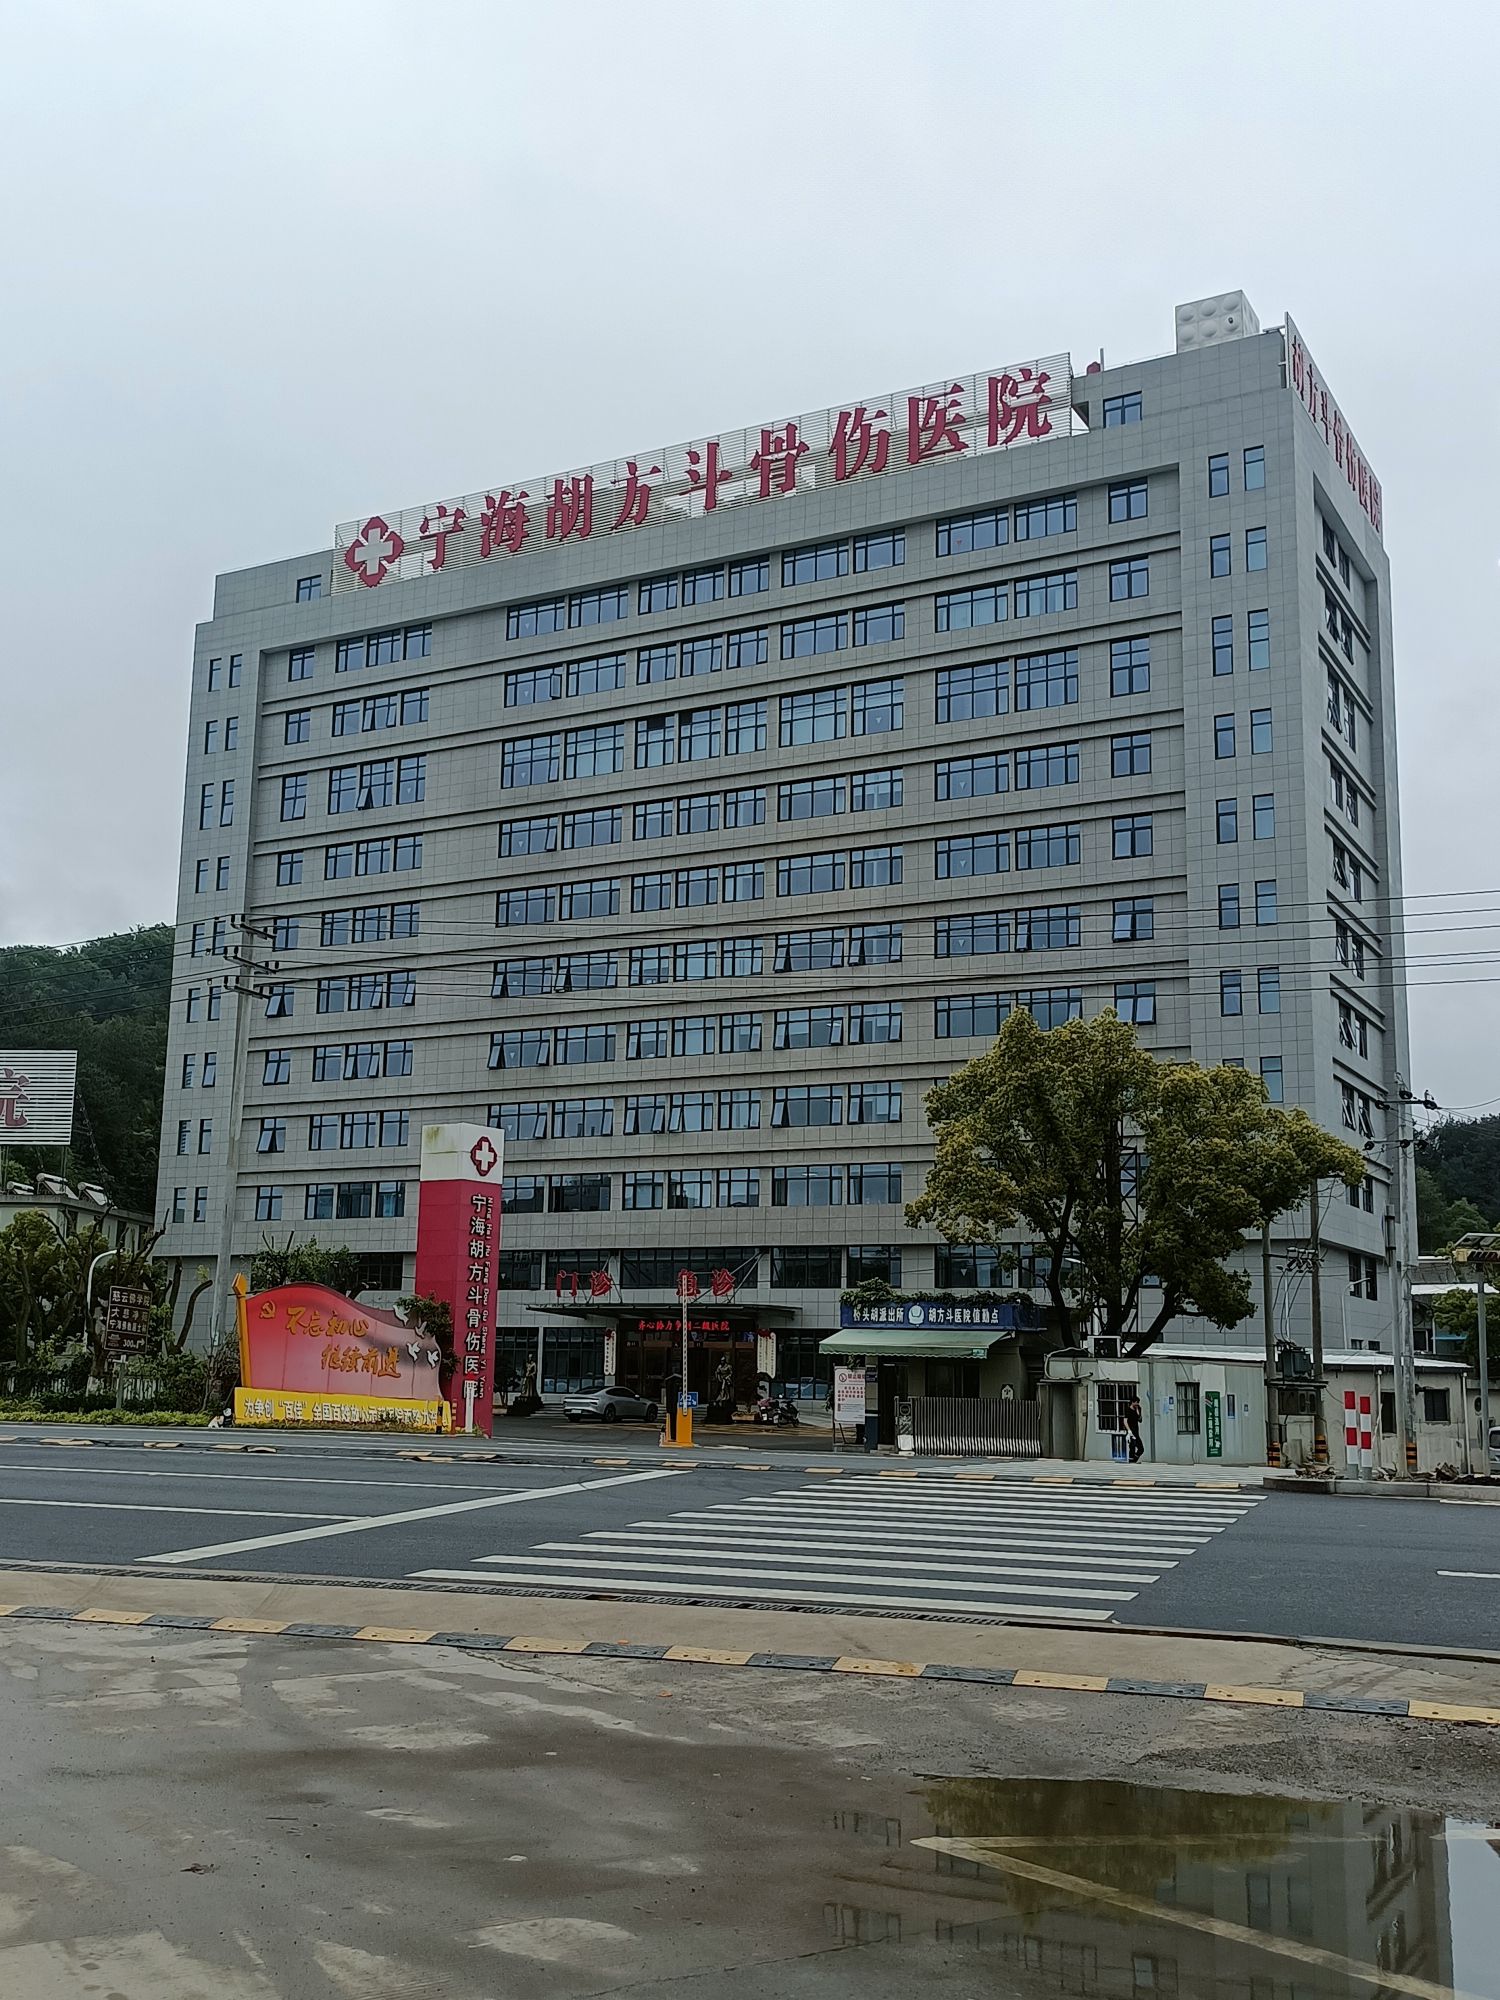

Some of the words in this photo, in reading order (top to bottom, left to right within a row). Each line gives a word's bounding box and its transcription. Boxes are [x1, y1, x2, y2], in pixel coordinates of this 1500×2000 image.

[1292, 335, 1380, 533] 胡方斗骨伤医院
[419, 368, 1053, 569] 宁海胡方斗骨伤医院
[556, 1270, 612, 1297] 门诊
[677, 1268, 735, 1296] 急诊
[286, 1306, 369, 1338] 不忘初心
